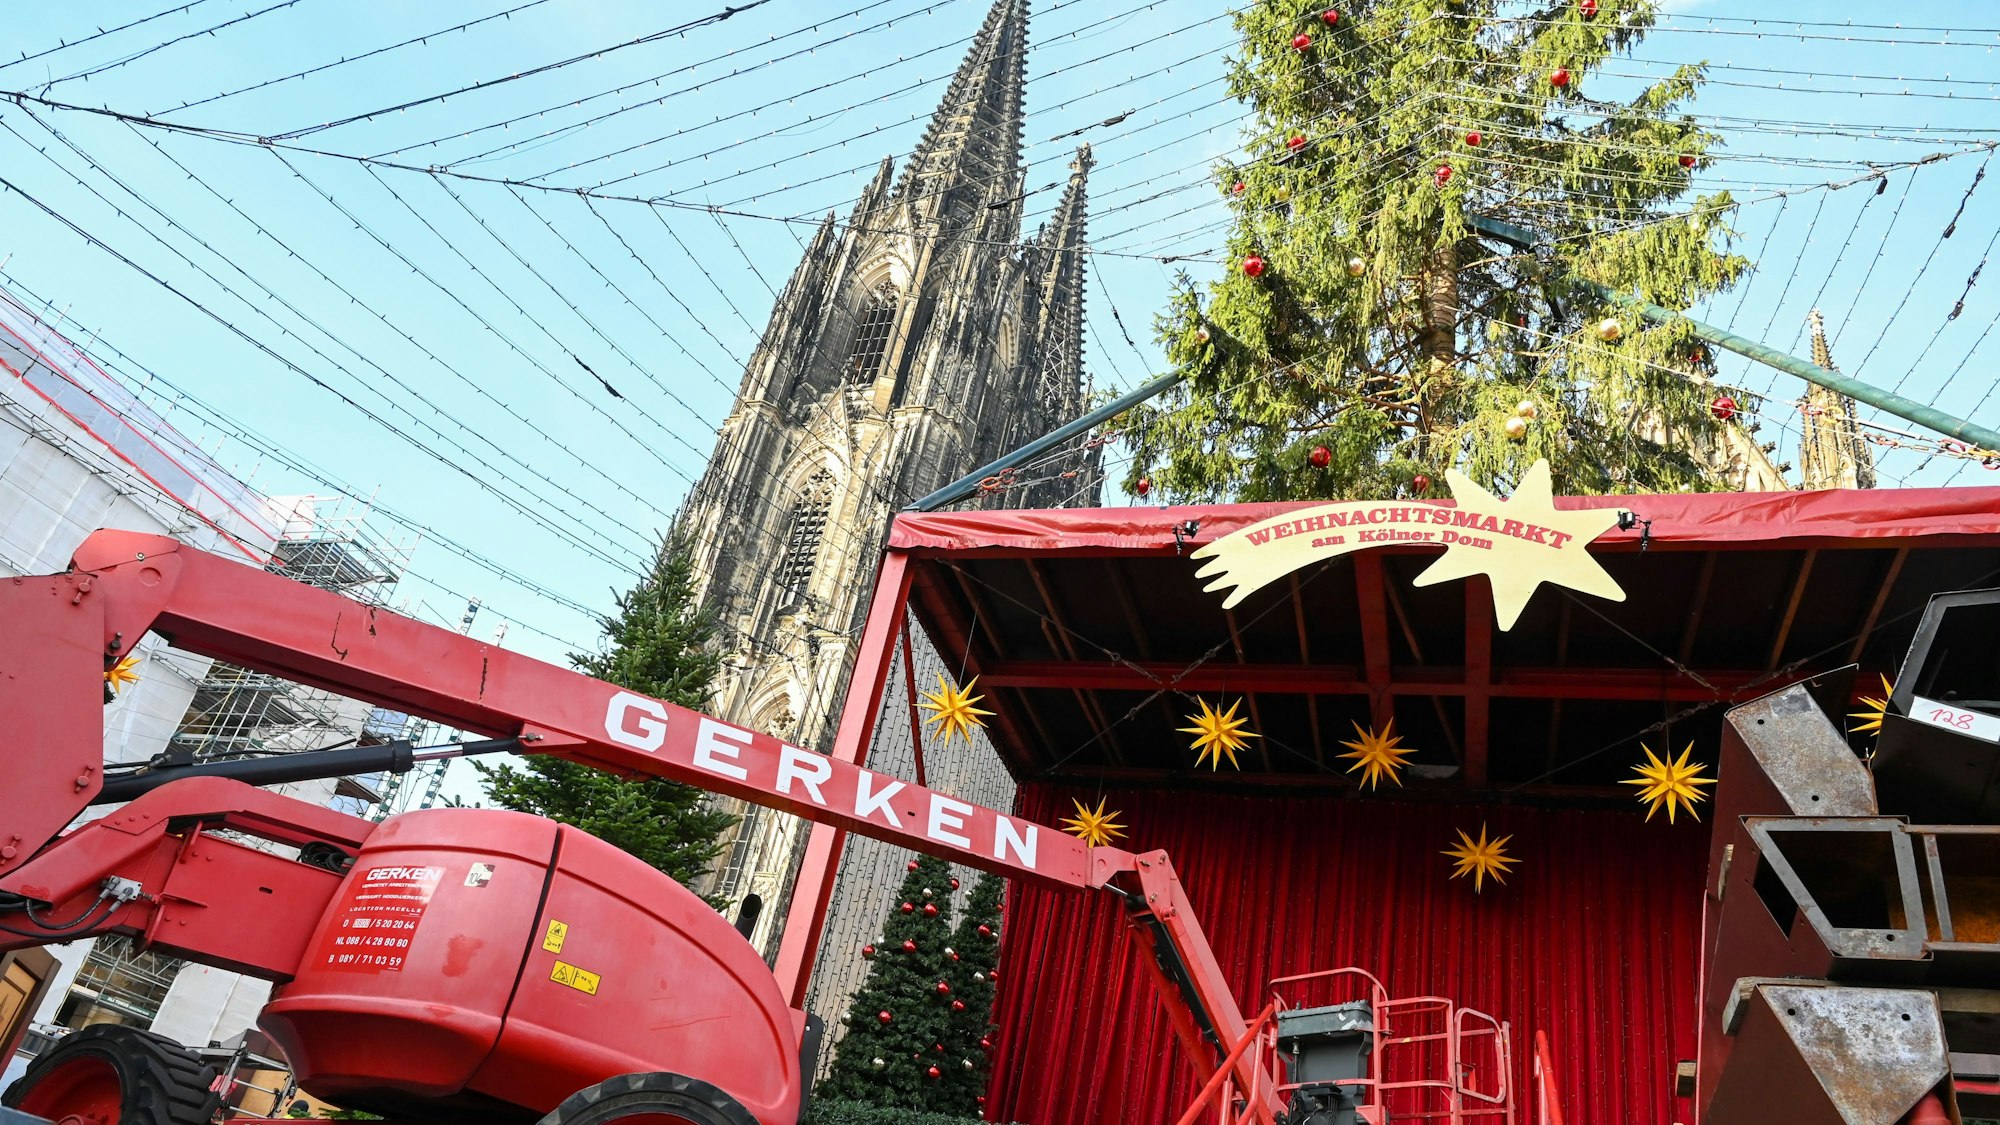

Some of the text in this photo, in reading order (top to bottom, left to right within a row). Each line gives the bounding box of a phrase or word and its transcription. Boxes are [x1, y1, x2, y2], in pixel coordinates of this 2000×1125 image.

[1245, 507, 1573, 550] WEIHNACHTSMARKT
[1311, 528, 1493, 550] am Kölner Dom
[1929, 708, 1974, 730] 128
[605, 691, 1037, 869] GERKEN
[366, 867, 443, 881] GERKEN
[342, 919, 350, 928] D
[335, 936, 345, 945] NL
[328, 954, 335, 963] B
[389, 957, 402, 966] 59
